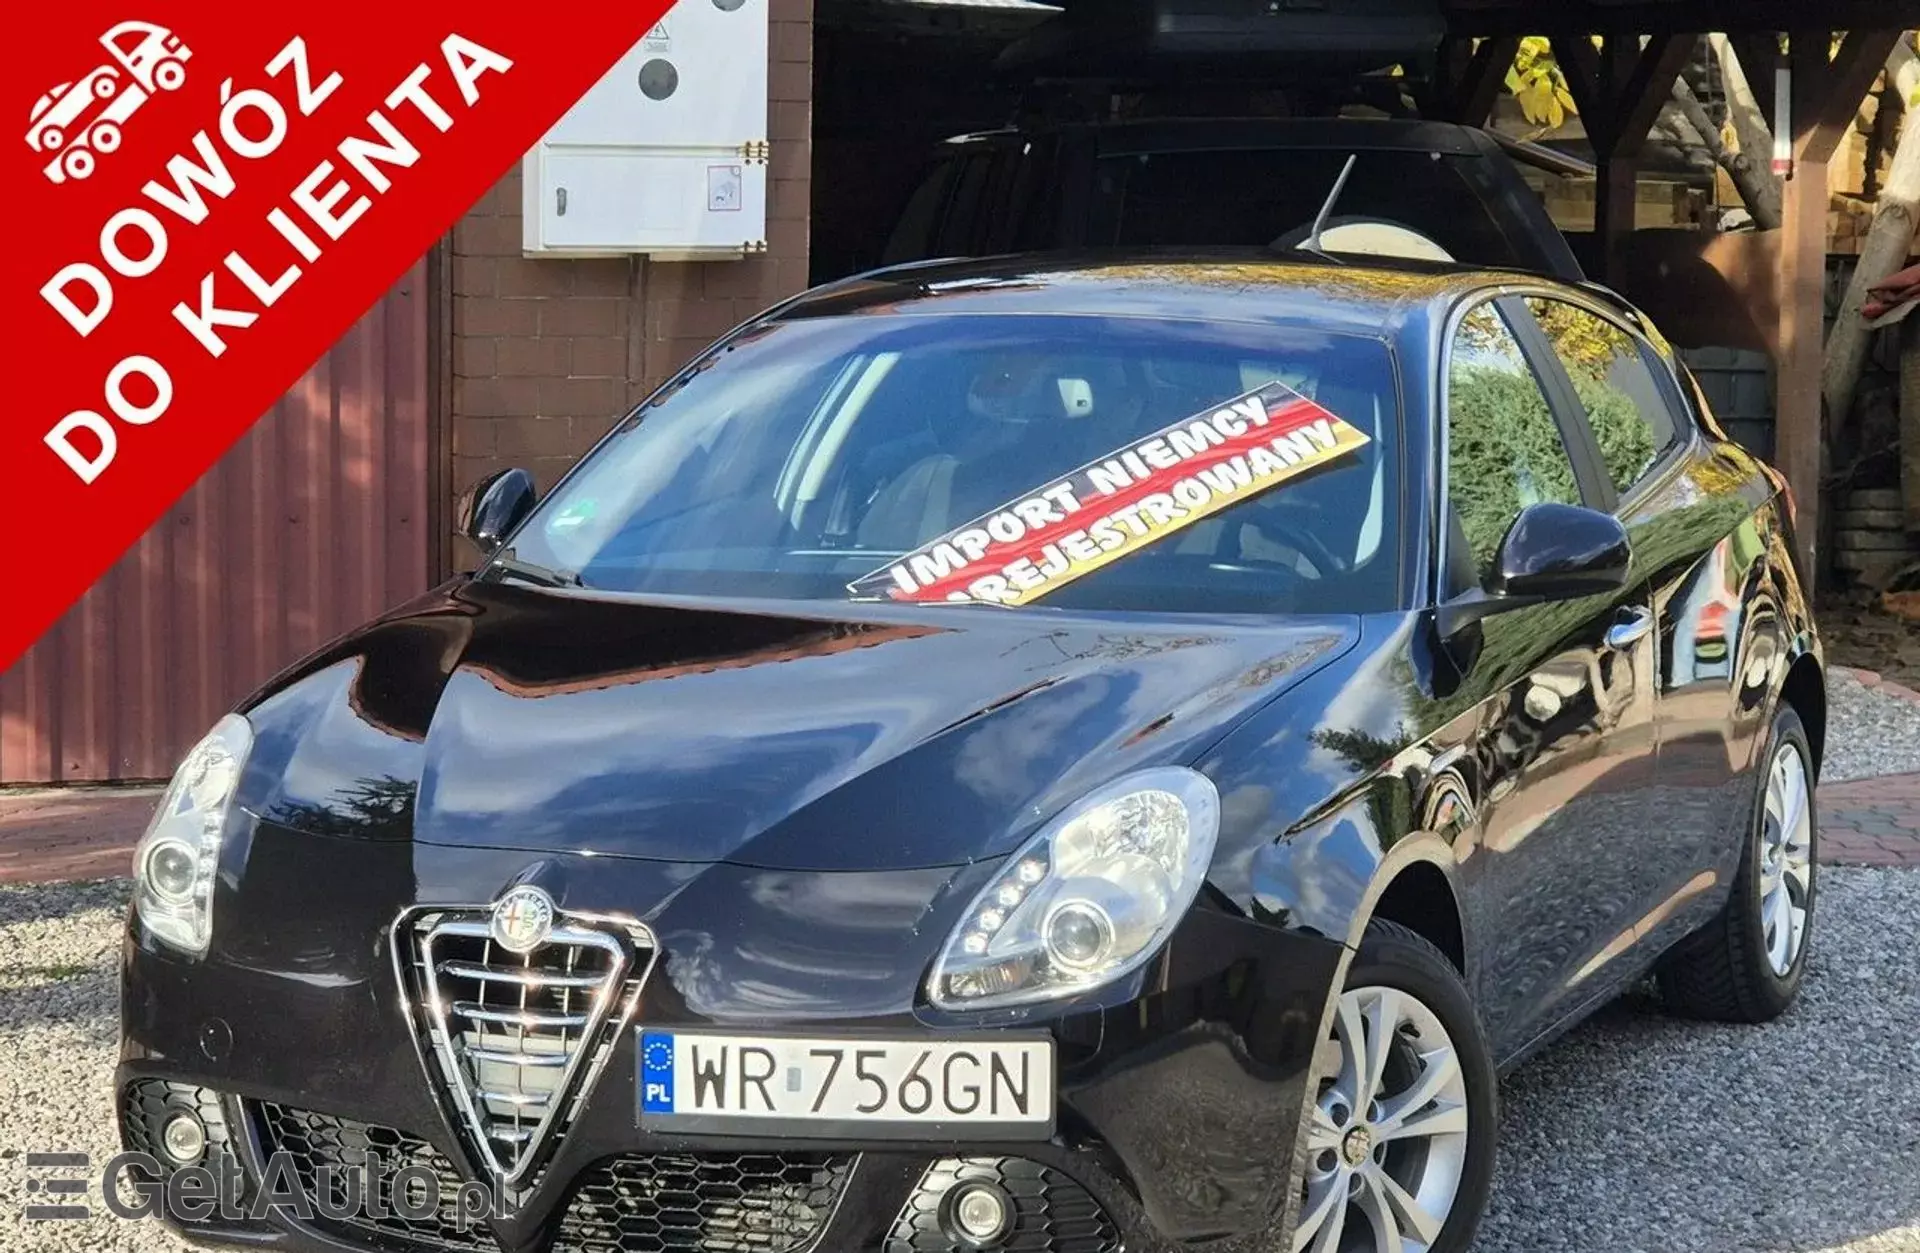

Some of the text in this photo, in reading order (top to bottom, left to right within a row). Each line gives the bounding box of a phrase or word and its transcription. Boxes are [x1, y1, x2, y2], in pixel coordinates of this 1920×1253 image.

[889, 396, 1270, 594] IMPORT NIEMCY
[946, 418, 1343, 603] REJESTROWANY
[647, 1083, 671, 1102] PL
[691, 1044, 1030, 1115] WR 756GN
